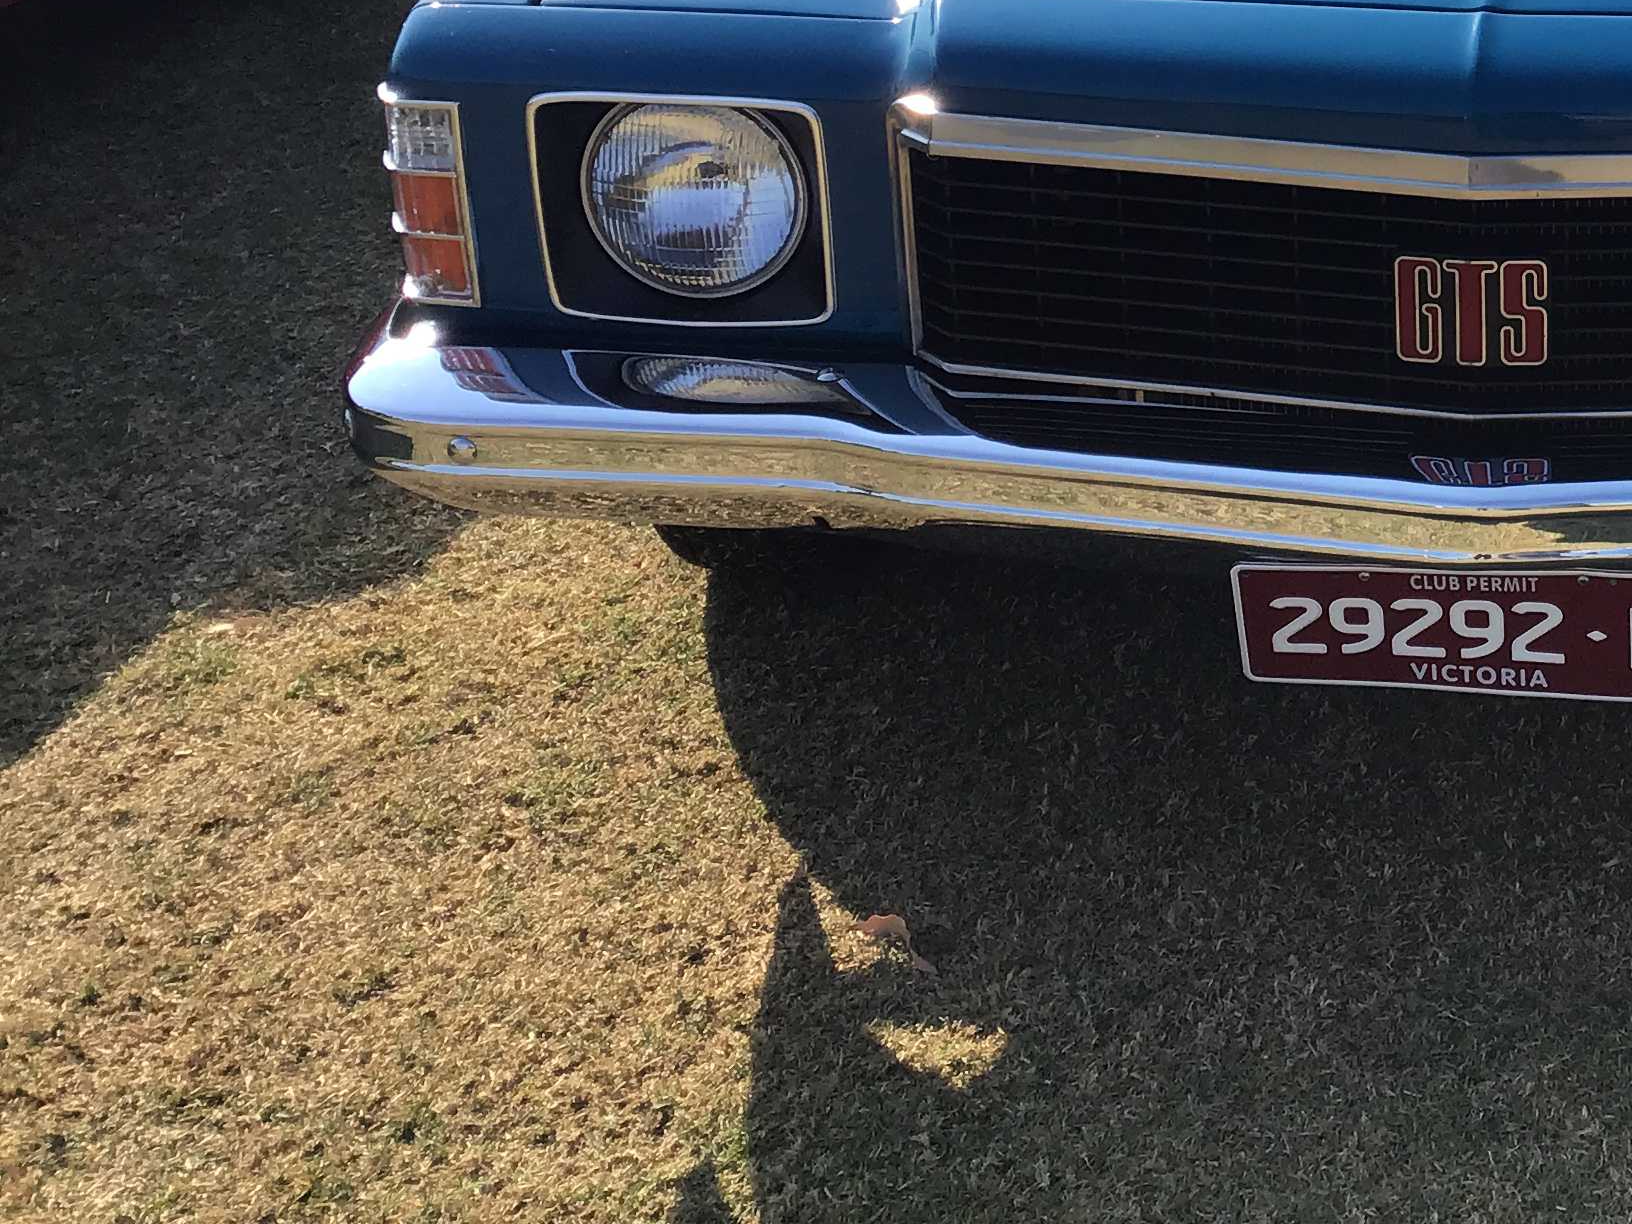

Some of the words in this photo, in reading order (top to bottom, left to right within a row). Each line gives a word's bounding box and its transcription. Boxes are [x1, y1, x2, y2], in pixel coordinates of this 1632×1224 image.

[1395, 256, 1547, 366] GTS
[1410, 574, 1460, 592] CLUB
[1466, 576, 1539, 593] PERMIT
[1269, 597, 1565, 663] 29292
[1411, 663, 1548, 688] VICTORIA
